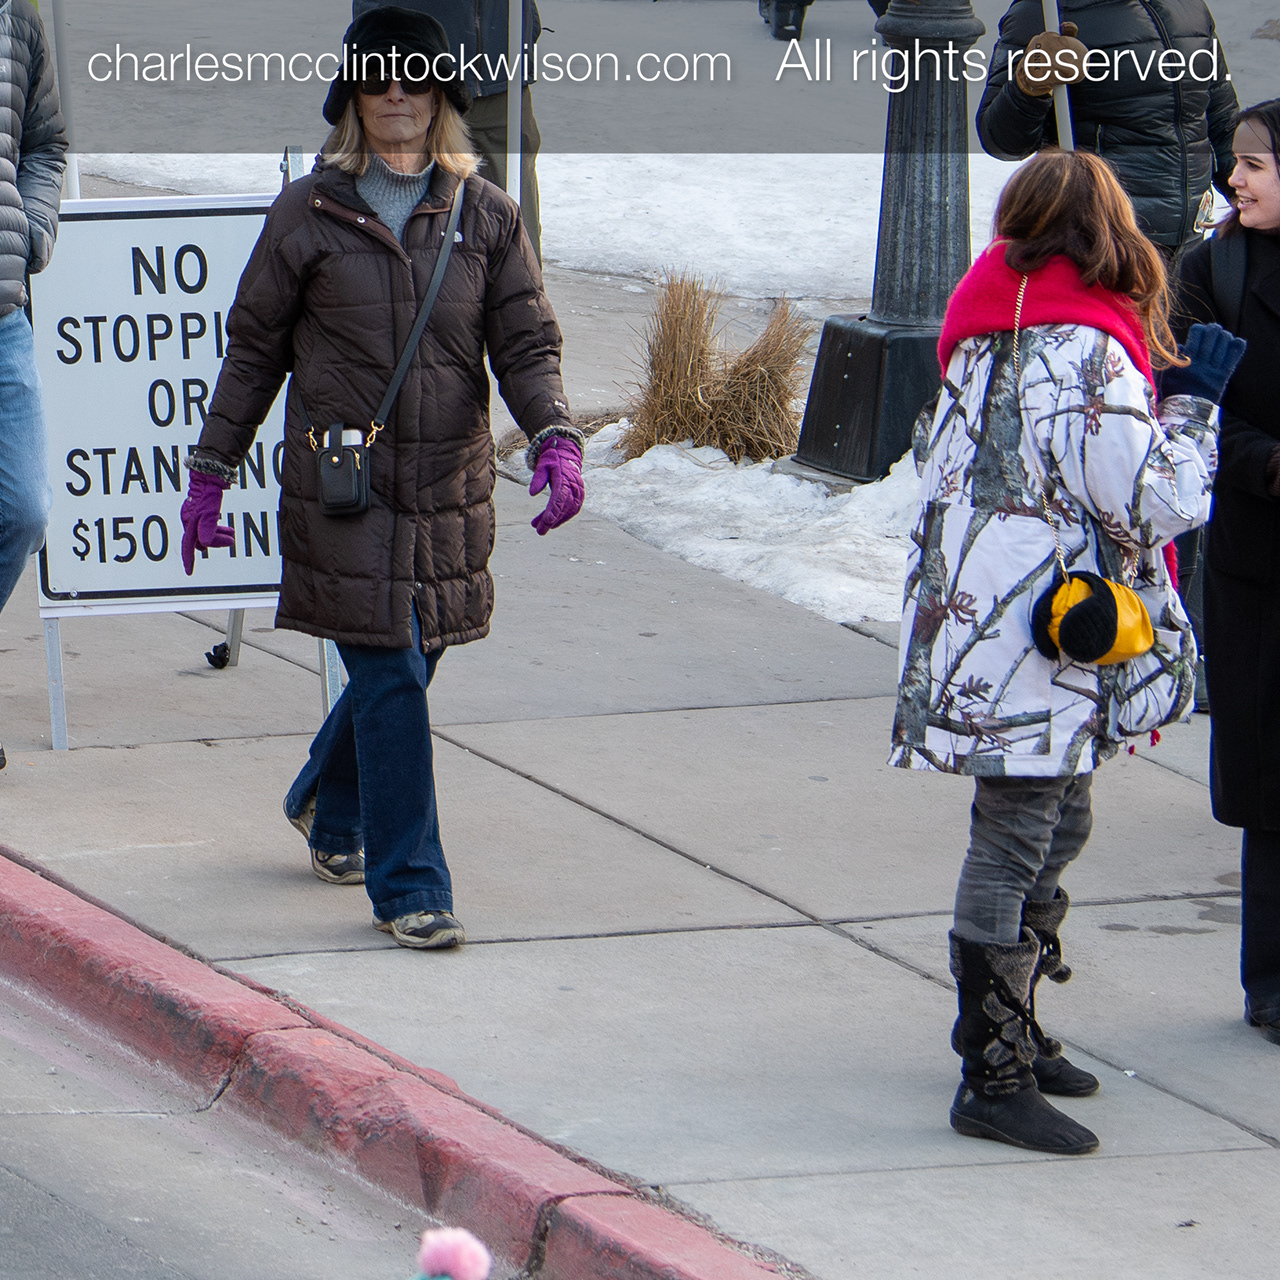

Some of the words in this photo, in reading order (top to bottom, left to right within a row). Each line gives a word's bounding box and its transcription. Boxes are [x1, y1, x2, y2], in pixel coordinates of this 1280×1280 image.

[131, 244, 209, 295] NO
[56, 311, 224, 365] STOPPI
[148, 378, 210, 427] OR
[65, 441, 284, 496] STANN
[72, 514, 169, 562] $150
[200, 510, 282, 560] IN
